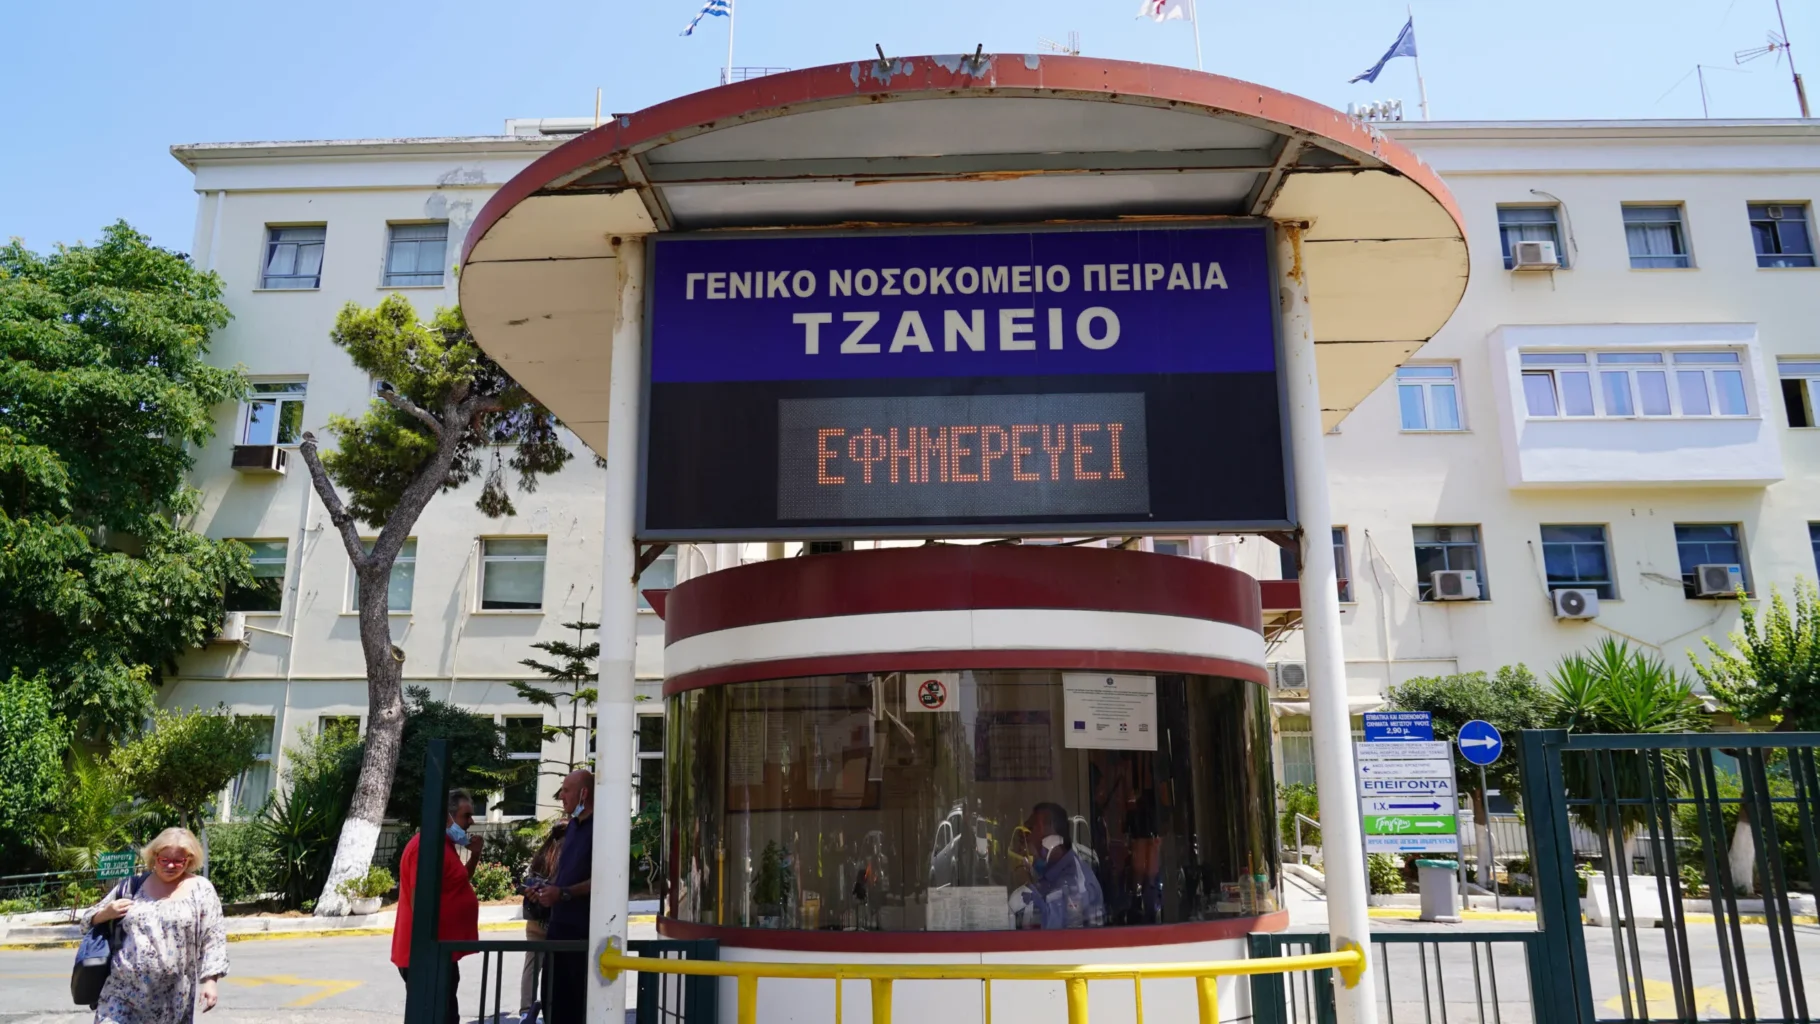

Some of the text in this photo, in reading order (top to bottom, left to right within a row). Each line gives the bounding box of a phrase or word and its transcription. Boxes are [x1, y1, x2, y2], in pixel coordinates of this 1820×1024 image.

[686, 261, 1229, 300] ΓΕΝΙΚΟ ΝΟΣΟΚΟΜΕΙΟ ΠΕΙΡΑΙΑ
[792, 306, 1122, 356] ΤΖΑΝΕΙΟ
[816, 422, 1126, 485] ΕΦΗΜΕΡΕΥΕΙ
[1364, 780, 1449, 789] ΕΠΕΙΓΟΝΤΑ
